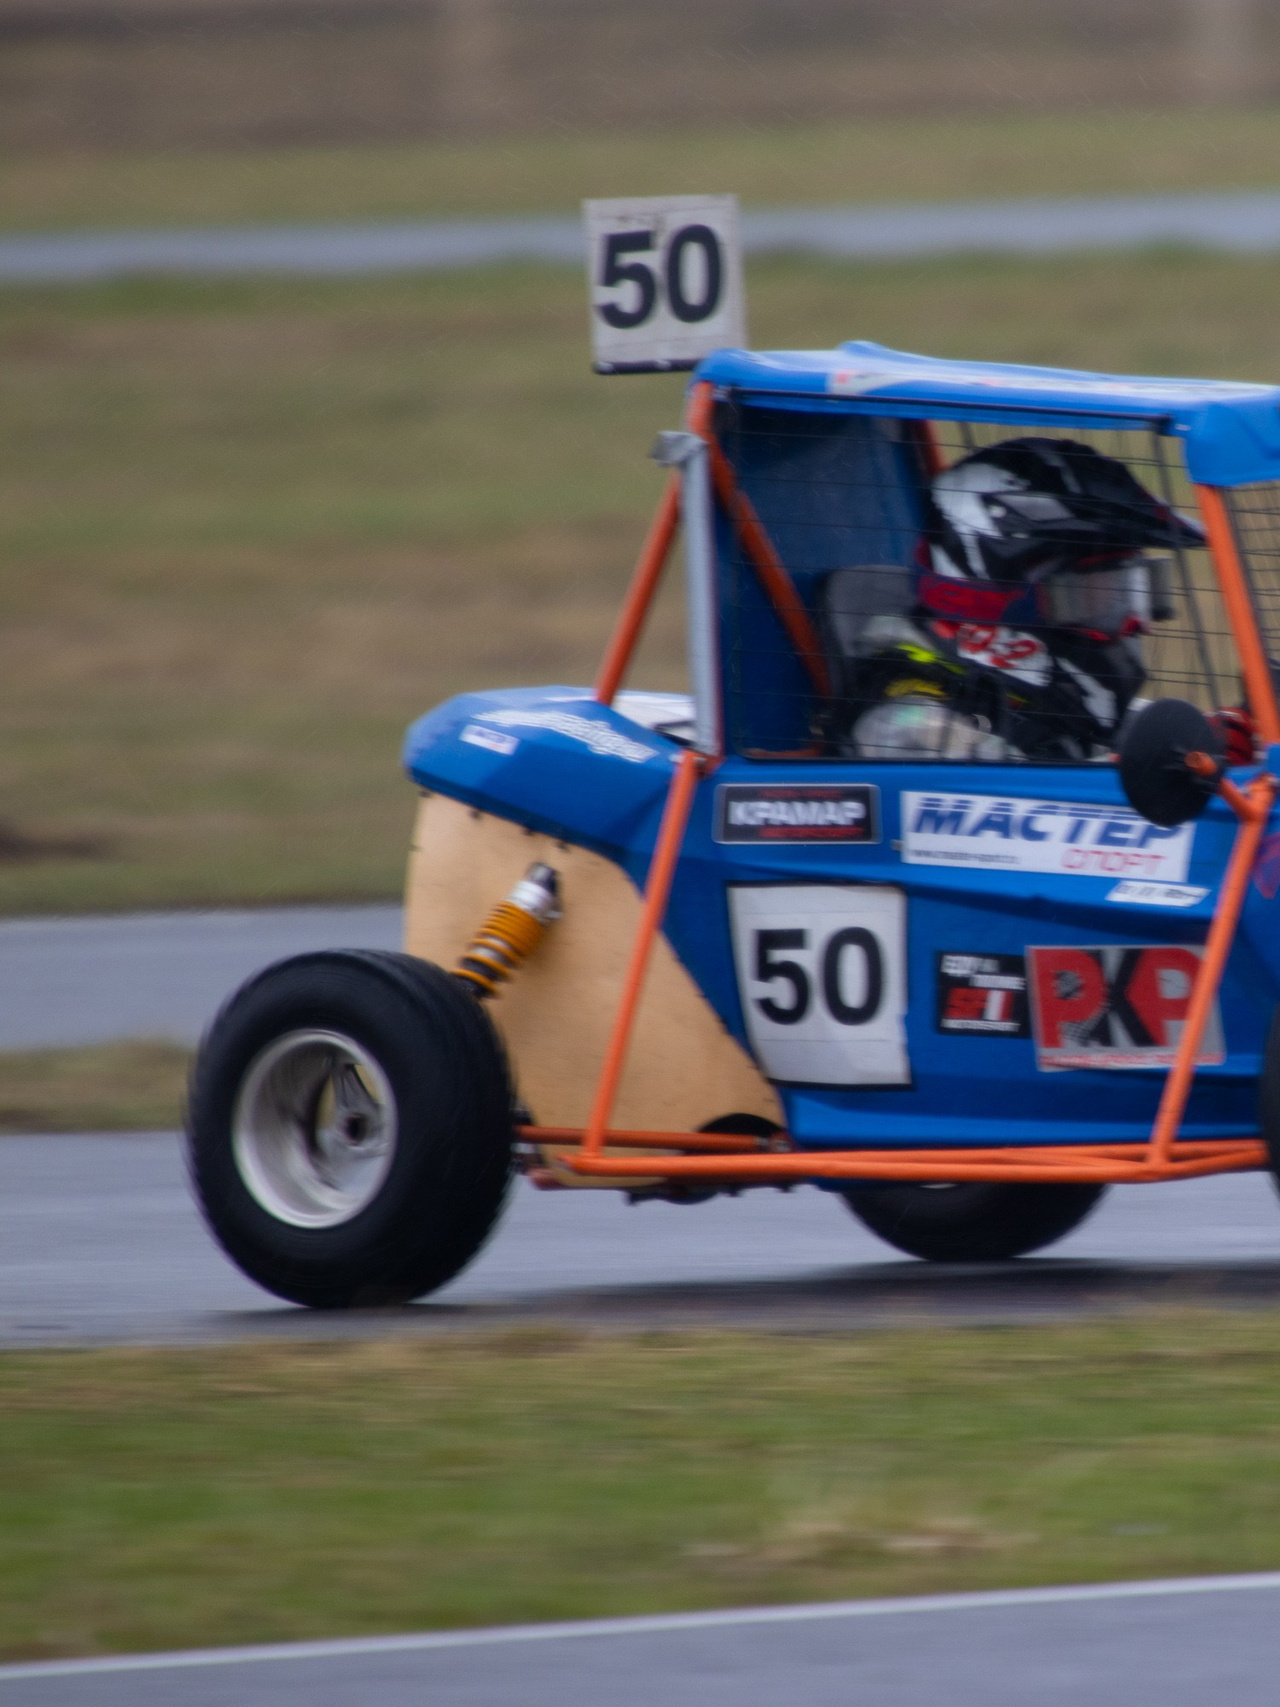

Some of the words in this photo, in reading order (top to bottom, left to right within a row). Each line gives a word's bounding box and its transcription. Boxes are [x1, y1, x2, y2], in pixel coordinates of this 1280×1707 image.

[597, 223, 722, 330] 50
[728, 800, 867, 826] КРАМАР
[912, 796, 1183, 850] МАСТЕР
[1060, 847, 1167, 875] СПОРТ
[753, 926, 885, 1027] 50
